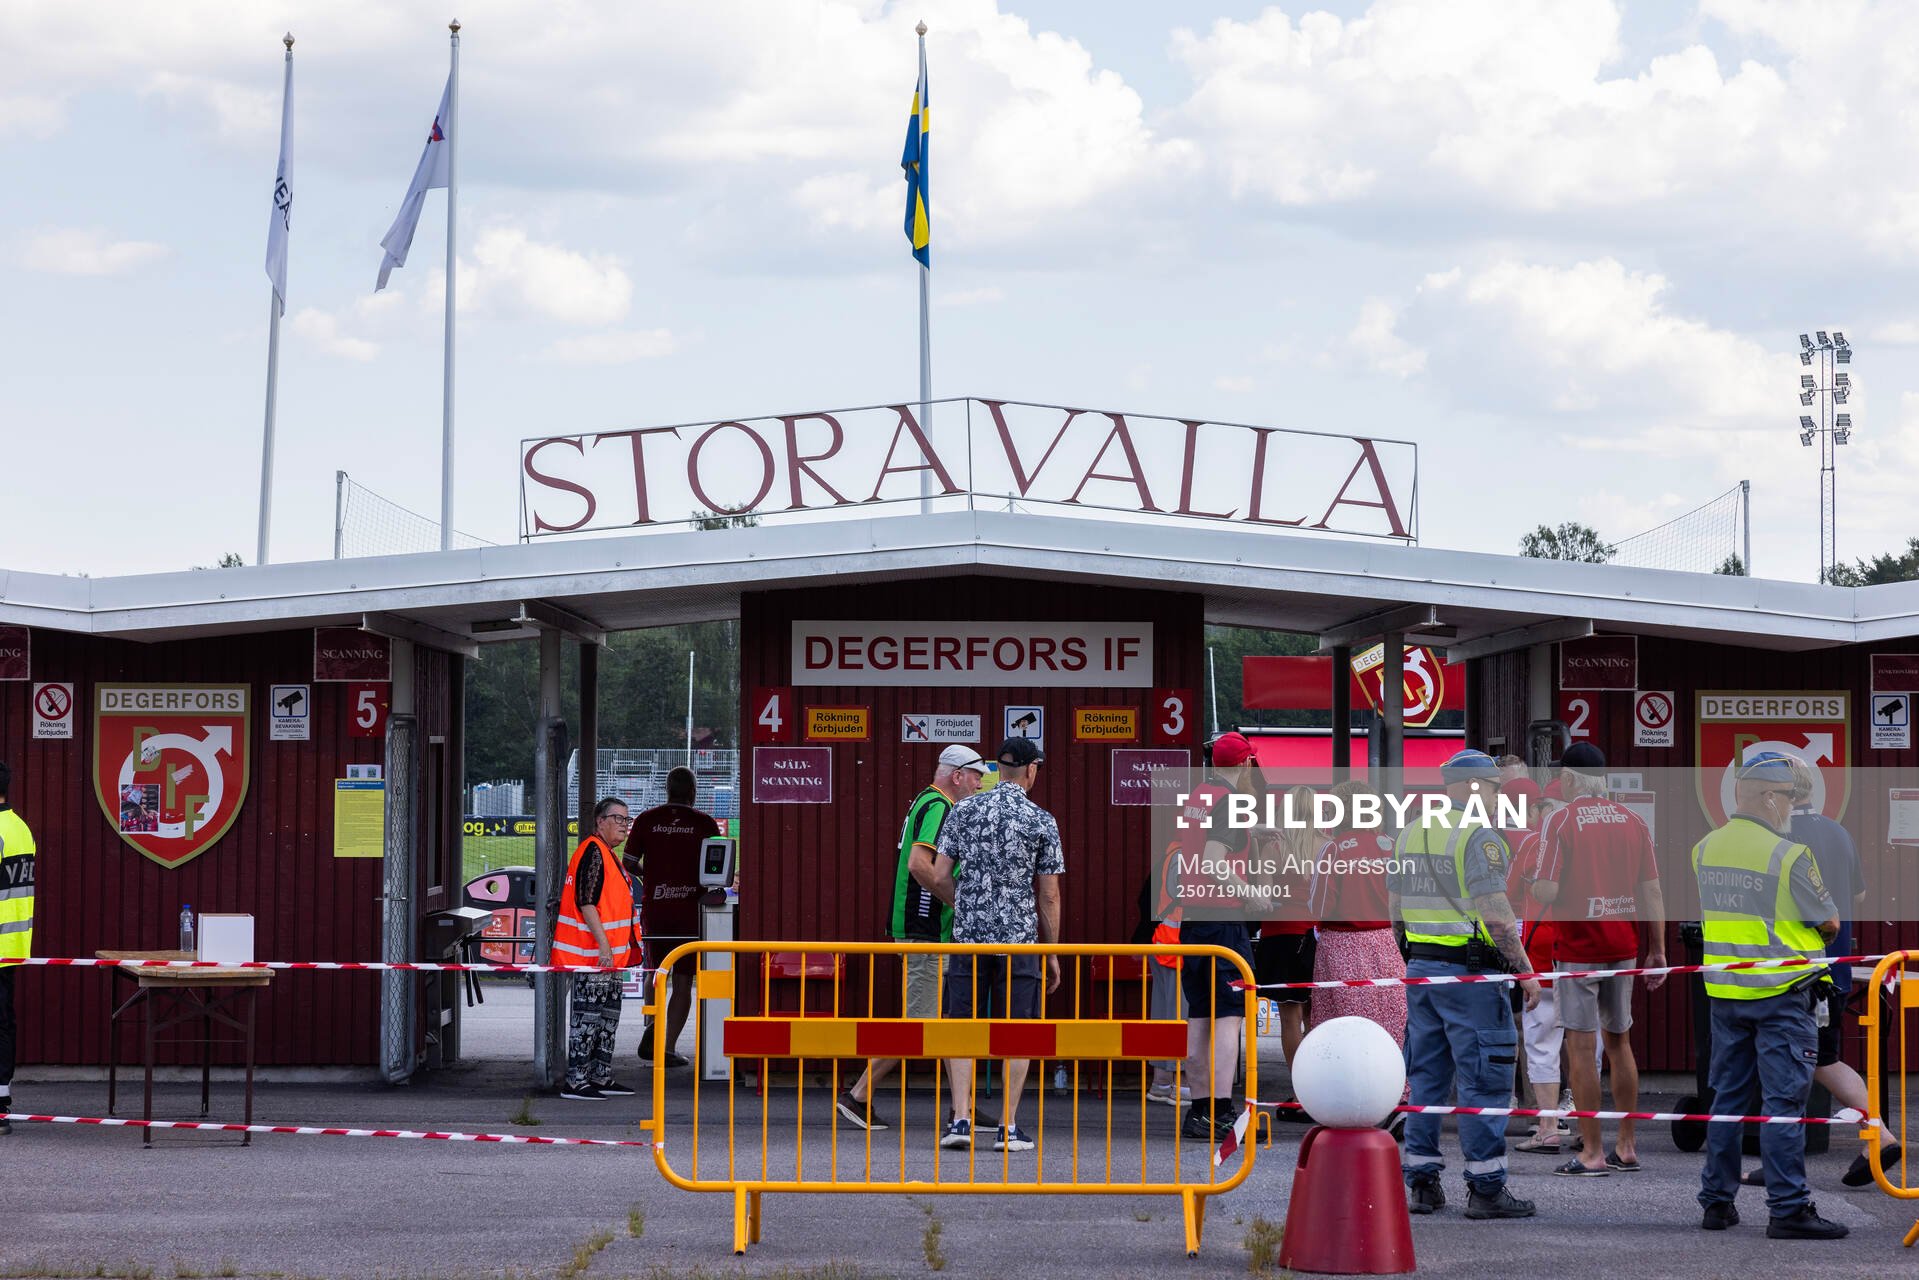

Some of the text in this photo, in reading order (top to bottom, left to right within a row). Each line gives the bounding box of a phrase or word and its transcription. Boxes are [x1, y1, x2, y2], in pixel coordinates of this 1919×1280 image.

[523, 400, 1414, 538] STORA VALLA
[0, 648, 21, 658] ING
[322, 648, 383, 659] SCANNING
[805, 635, 1141, 672] DEGERFORS IF
[1568, 658, 1630, 668] SCANNING
[105, 692, 240, 709] DEGERFORS
[356, 690, 378, 729] 5
[758, 694, 783, 733] 4
[1706, 700, 1840, 716] DEGERFORS
[816, 712, 860, 723] Rökning
[1084, 713, 1128, 724] Rökning
[1162, 696, 1185, 736] 3
[1567, 698, 1590, 737] 2
[40, 721, 66, 729] Rökning
[936, 718, 974, 728] Förbjudet
[813, 724, 863, 734] förbjuden
[934, 728, 975, 737] för hundar
[1081, 725, 1132, 735] förbjuden
[1641, 729, 1668, 737] Rökning
[1639, 737, 1670, 745] förbjuden
[773, 758, 812, 769] SJÄLV-
[1132, 761, 1170, 772] SJÄLV-
[761, 776, 823, 786] SCANNING
[1120, 778, 1181, 788] SCANNING
[1576, 802, 1619, 816] maint
[1576, 813, 1629, 832] partner
[652, 823, 694, 835] skogsmat
[1702, 870, 1764, 892] ORDNINGS
[1713, 892, 1745, 908] VAKT
